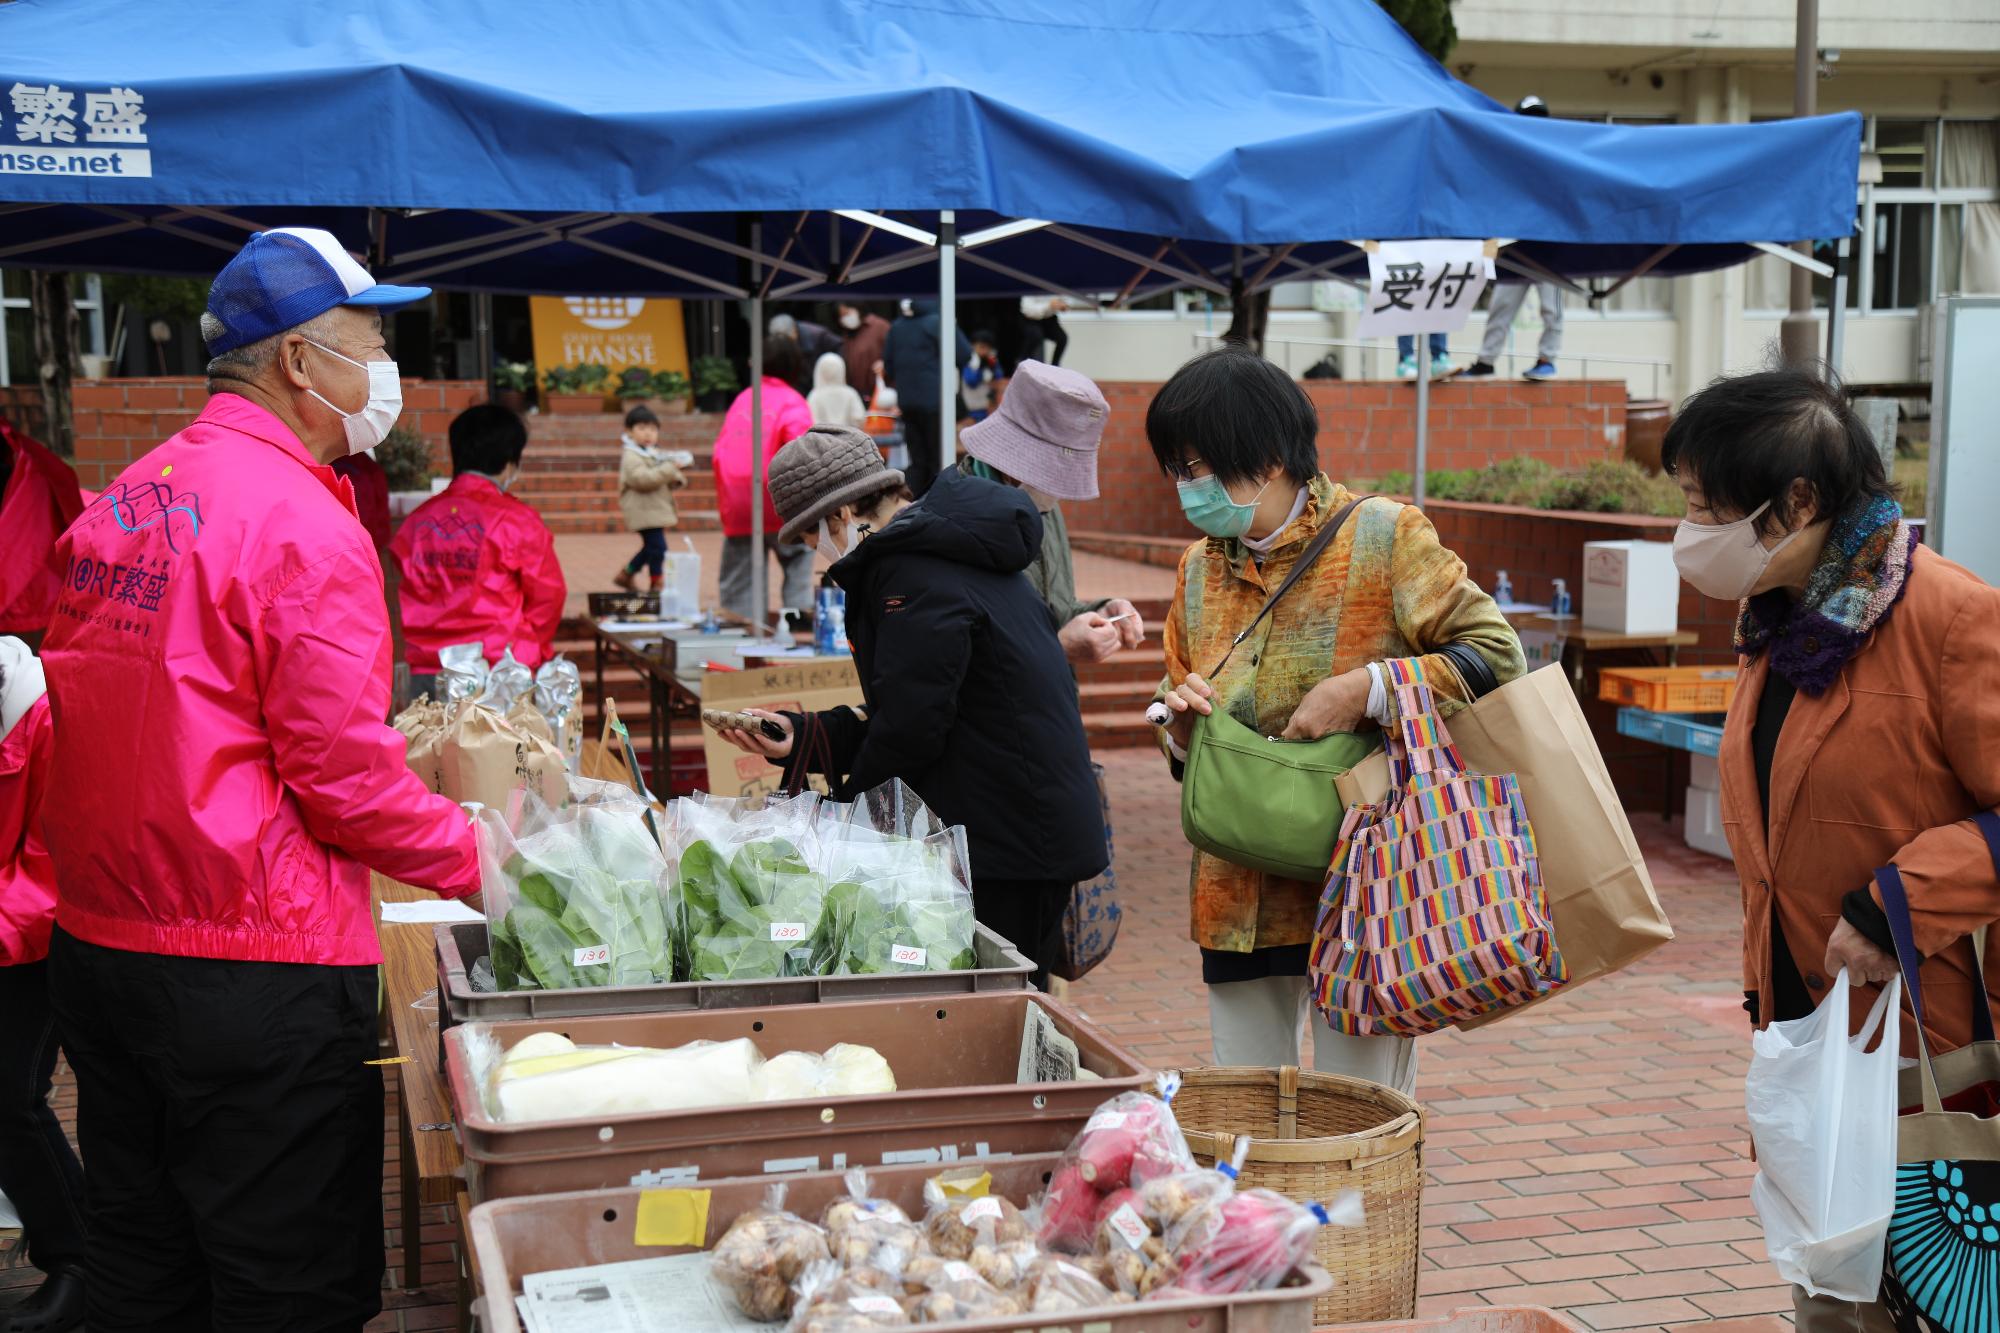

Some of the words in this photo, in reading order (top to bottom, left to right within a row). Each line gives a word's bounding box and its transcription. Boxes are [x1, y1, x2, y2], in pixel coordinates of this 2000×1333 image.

[0, 82, 148, 143] 繁盛
[1373, 261, 1476, 314] 受付
[563, 345, 657, 365] HANSE
[775, 927, 799, 937] 130
[580, 950, 606, 962] 130
[895, 950, 918, 961] 130
